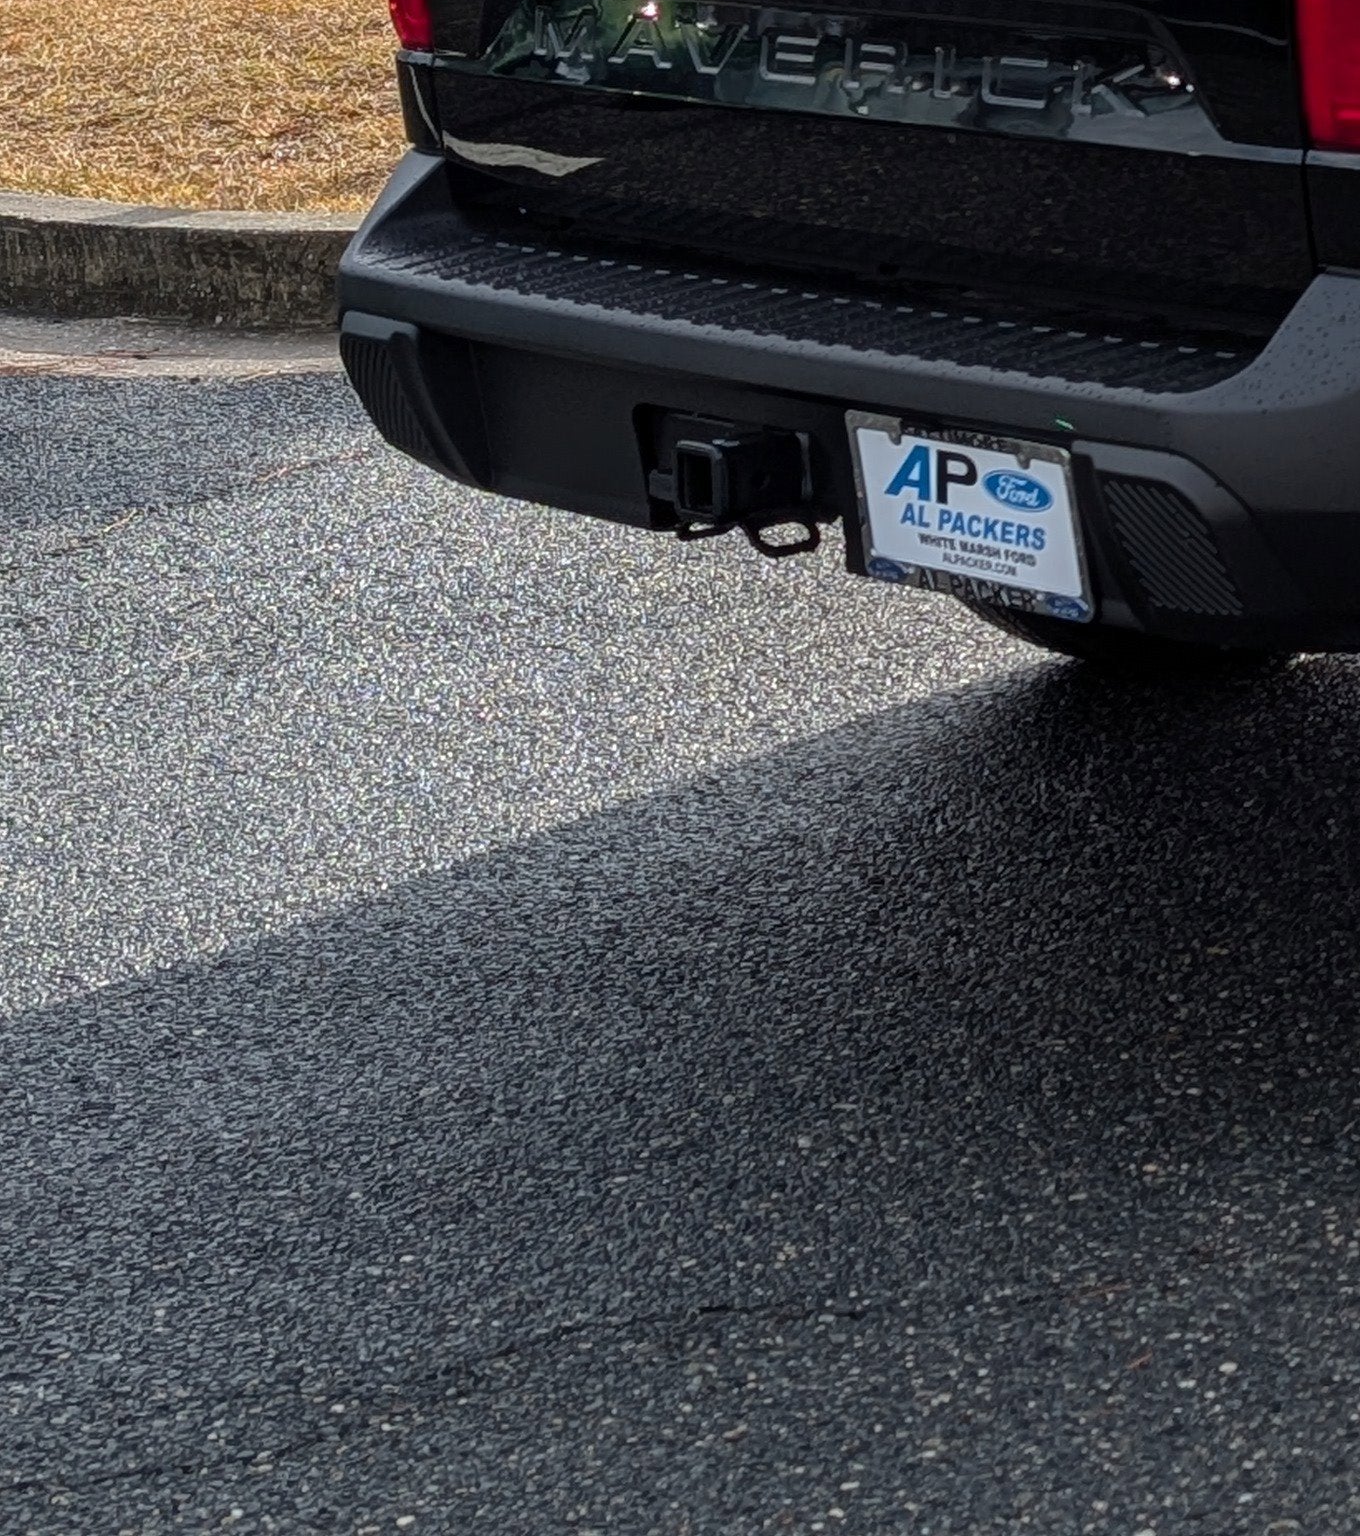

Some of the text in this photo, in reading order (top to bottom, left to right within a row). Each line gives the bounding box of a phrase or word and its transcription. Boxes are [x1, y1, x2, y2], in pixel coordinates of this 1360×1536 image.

[533, 5, 1146, 118] MAVERICK
[884, 444, 978, 505] AP
[996, 475, 1040, 506] Ford
[900, 502, 1046, 551] AL PACKERS
[918, 533, 956, 551] WHITE
[1004, 549, 1037, 567] FORD
